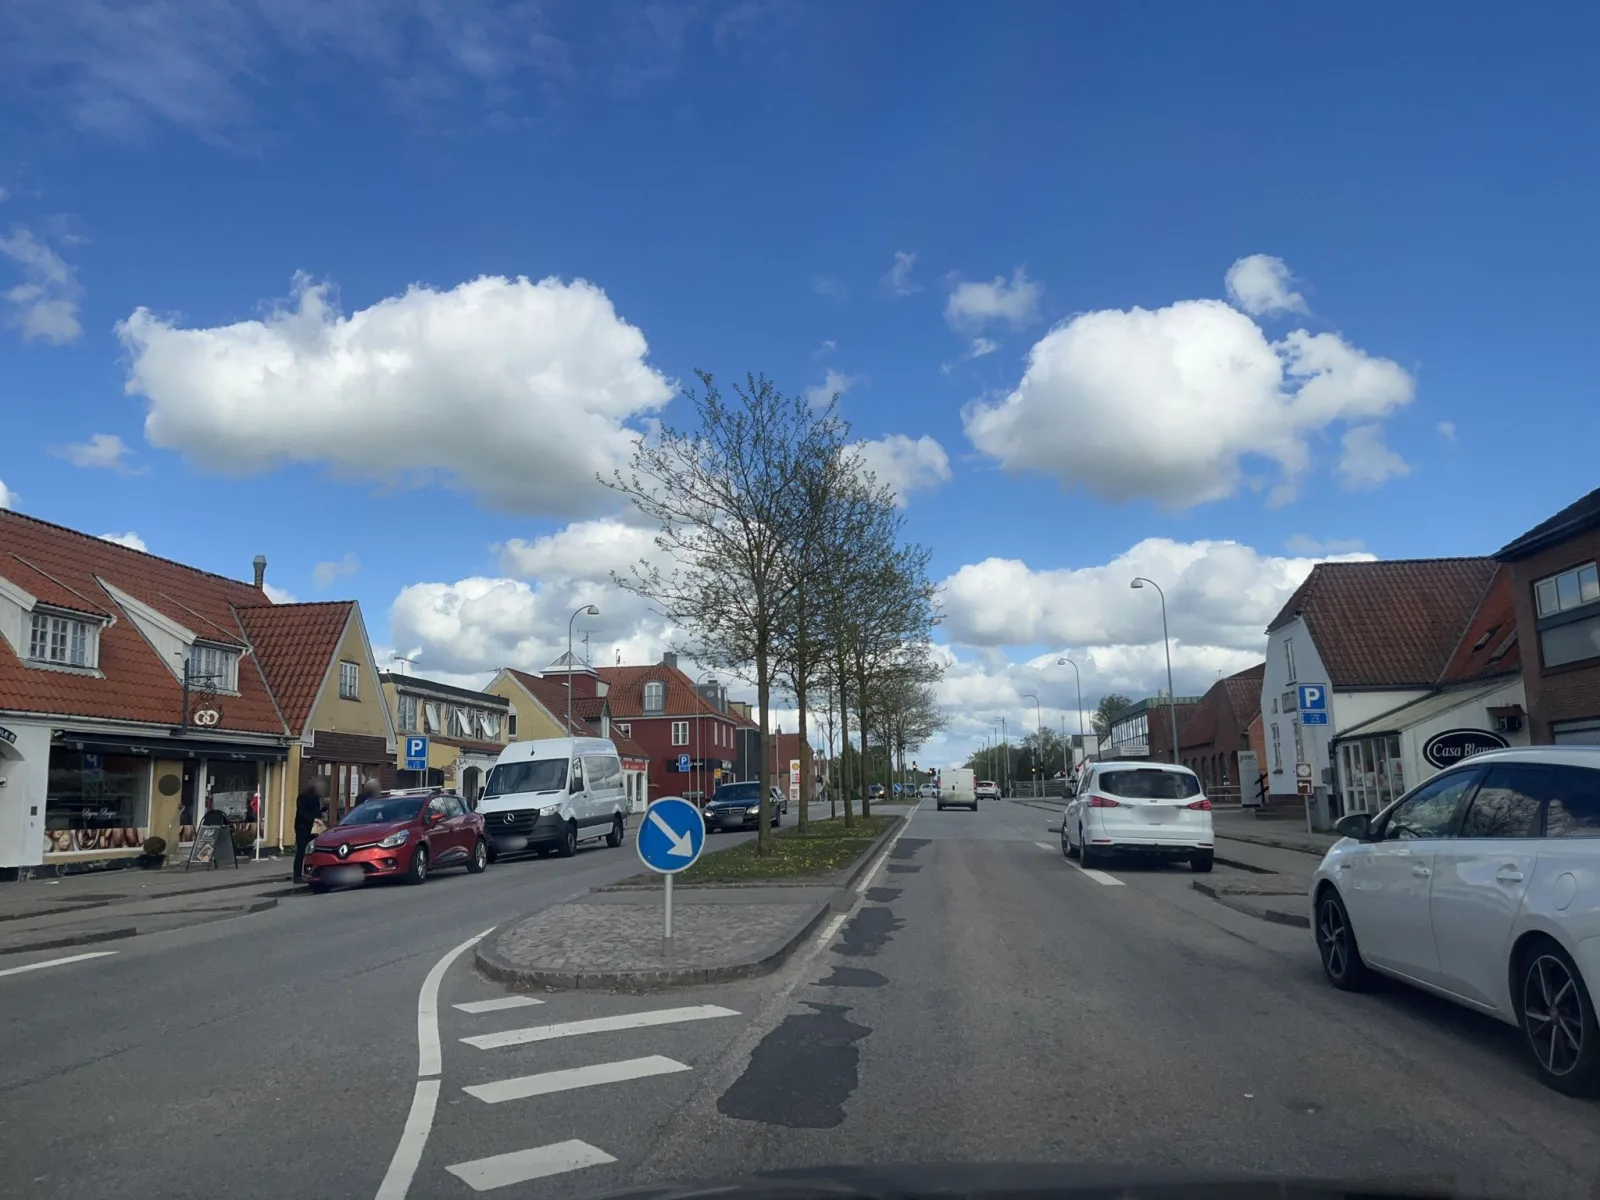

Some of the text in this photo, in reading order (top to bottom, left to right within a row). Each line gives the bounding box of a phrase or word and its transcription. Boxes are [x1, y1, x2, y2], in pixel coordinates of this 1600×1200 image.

[1304, 687, 1320, 708] P
[411, 739, 423, 756] P
[1433, 743, 1461, 757] Casa
[681, 756, 687, 765] P
